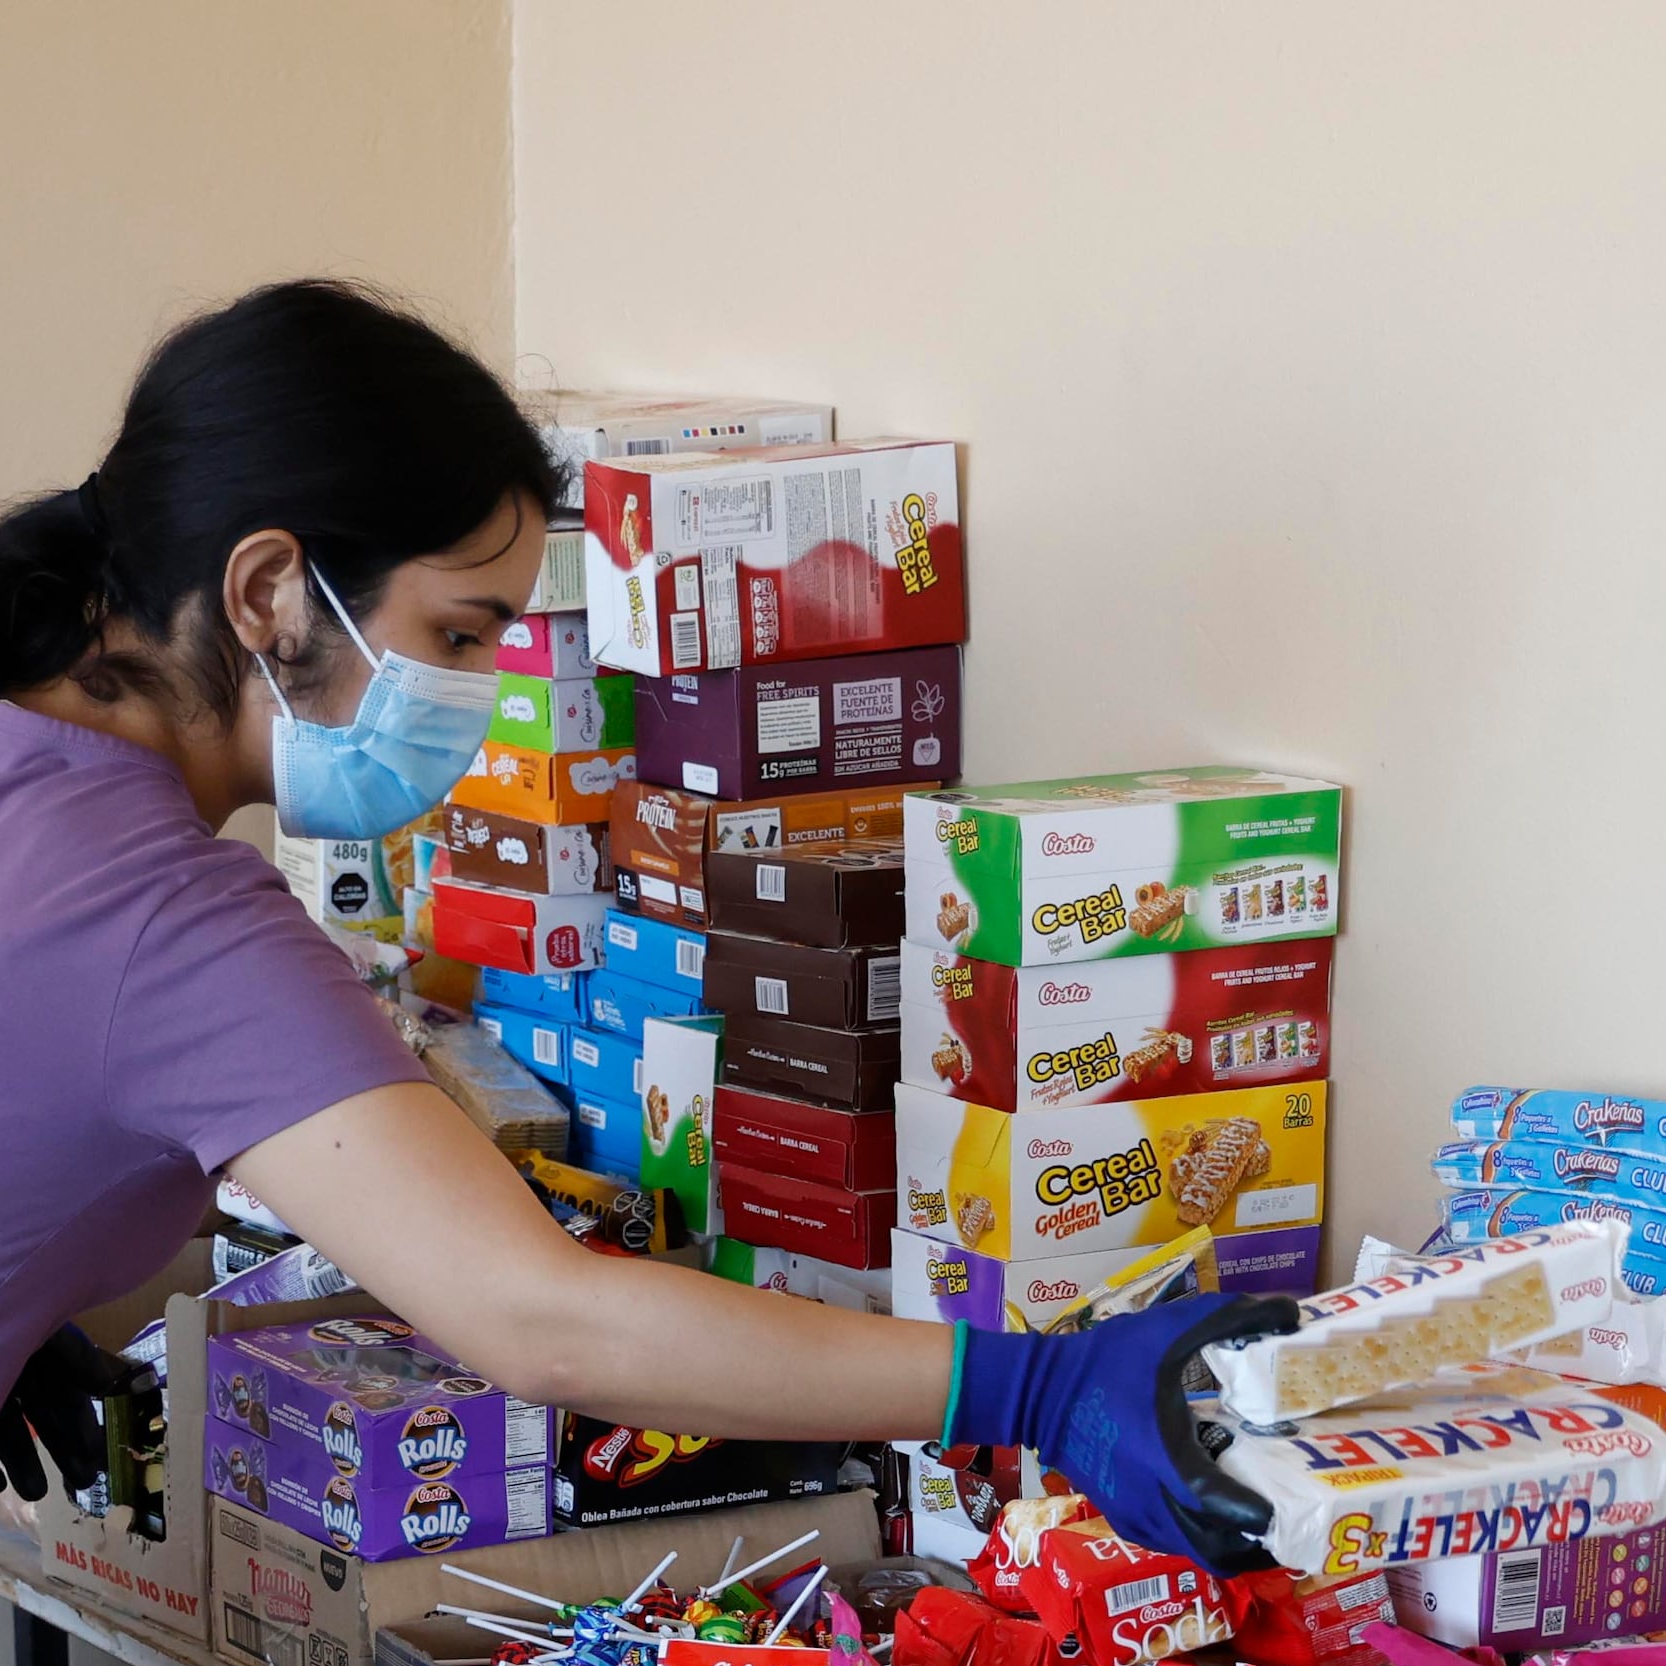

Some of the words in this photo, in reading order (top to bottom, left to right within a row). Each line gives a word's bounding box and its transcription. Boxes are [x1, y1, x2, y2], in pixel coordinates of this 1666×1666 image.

[902, 492, 939, 590] Cereal
[895, 547, 922, 596] Bar
[757, 681, 772, 690] Food
[774, 680, 786, 688] for
[757, 688, 780, 701] FREE
[783, 686, 819, 698] SPIRITS
[841, 683, 893, 697] EXCELENTE
[841, 697, 877, 708] FUENTE
[880, 694, 893, 705] DE
[841, 704, 893, 718] PROTEÍNAS
[835, 735, 902, 749] NATURALMENTE
[835, 749, 858, 759] LIBRE
[860, 747, 870, 757] DE
[872, 744, 902, 756] SELLOS
[788, 827, 845, 842] EXCELENTE
[935, 816, 978, 842] Cereal
[332, 843, 368, 862] 480g
[957, 835, 979, 855] Bar
[1042, 833, 1094, 857] Costa
[1032, 883, 1122, 934] Cereal
[1080, 906, 1126, 944] Bar
[932, 964, 972, 986] Cereal
[952, 982, 973, 1001] Bar
[1039, 982, 1090, 1005] Costa
[790, 1058, 808, 1070] BARRA
[808, 1062, 828, 1074] CEREAL
[1027, 1032, 1118, 1083] Cereal
[1075, 1055, 1121, 1091] Bar
[1285, 1094, 1312, 1118] 20
[1574, 1096, 1644, 1132] Crakeñas
[693, 1094, 706, 1166] Cereal
[1284, 1116, 1313, 1129] Barras
[686, 1131, 697, 1167] Bar
[780, 1137, 798, 1148] BARRA
[799, 1141, 819, 1153] CEREAL
[1028, 1138, 1072, 1159] Costa
[1036, 1139, 1157, 1205] Cereal
[1553, 1149, 1620, 1177] Crakeñas
[907, 1189, 945, 1211] Cereal
[1100, 1166, 1163, 1216] Bar
[927, 1205, 948, 1225] Bar
[1035, 1201, 1098, 1236] Golden
[1054, 1213, 1100, 1241] Cereal
[926, 1258, 968, 1284] Cereal
[947, 1274, 969, 1295] Bar
[1028, 1280, 1079, 1305] Costa
[1560, 1277, 1606, 1304] Costa
[319, 1319, 393, 1345] Rolls
[1589, 1328, 1629, 1350] Costa
[414, 1411, 449, 1426] Costa
[322, 1425, 362, 1472] Rolls
[397, 1429, 467, 1468] Rolls
[1292, 1403, 1625, 1470] CRACKELET
[1564, 1431, 1654, 1458] Costa
[591, 1427, 631, 1473] Nestlé
[804, 1480, 823, 1492] 696g
[919, 1473, 953, 1495] Cereal
[1330, 1467, 1405, 1487] TRIPACK
[417, 1487, 451, 1504] Costa
[581, 1510, 608, 1523] Oblea
[610, 1504, 642, 1520] Bañada
[644, 1503, 659, 1515] con
[661, 1497, 701, 1513] cobertura
[702, 1494, 725, 1506] sabor
[727, 1488, 768, 1503] Chocolate
[937, 1492, 956, 1509] Bar
[322, 1499, 362, 1543] Rolls
[400, 1505, 471, 1545] Rolls
[55, 1540, 87, 1572] MÁS
[92, 1556, 133, 1591] RICAS
[136, 1575, 161, 1603] NO
[165, 1589, 199, 1616] HAY
[995, 1570, 1020, 1586] Costa
[1139, 1599, 1183, 1624] Costa
